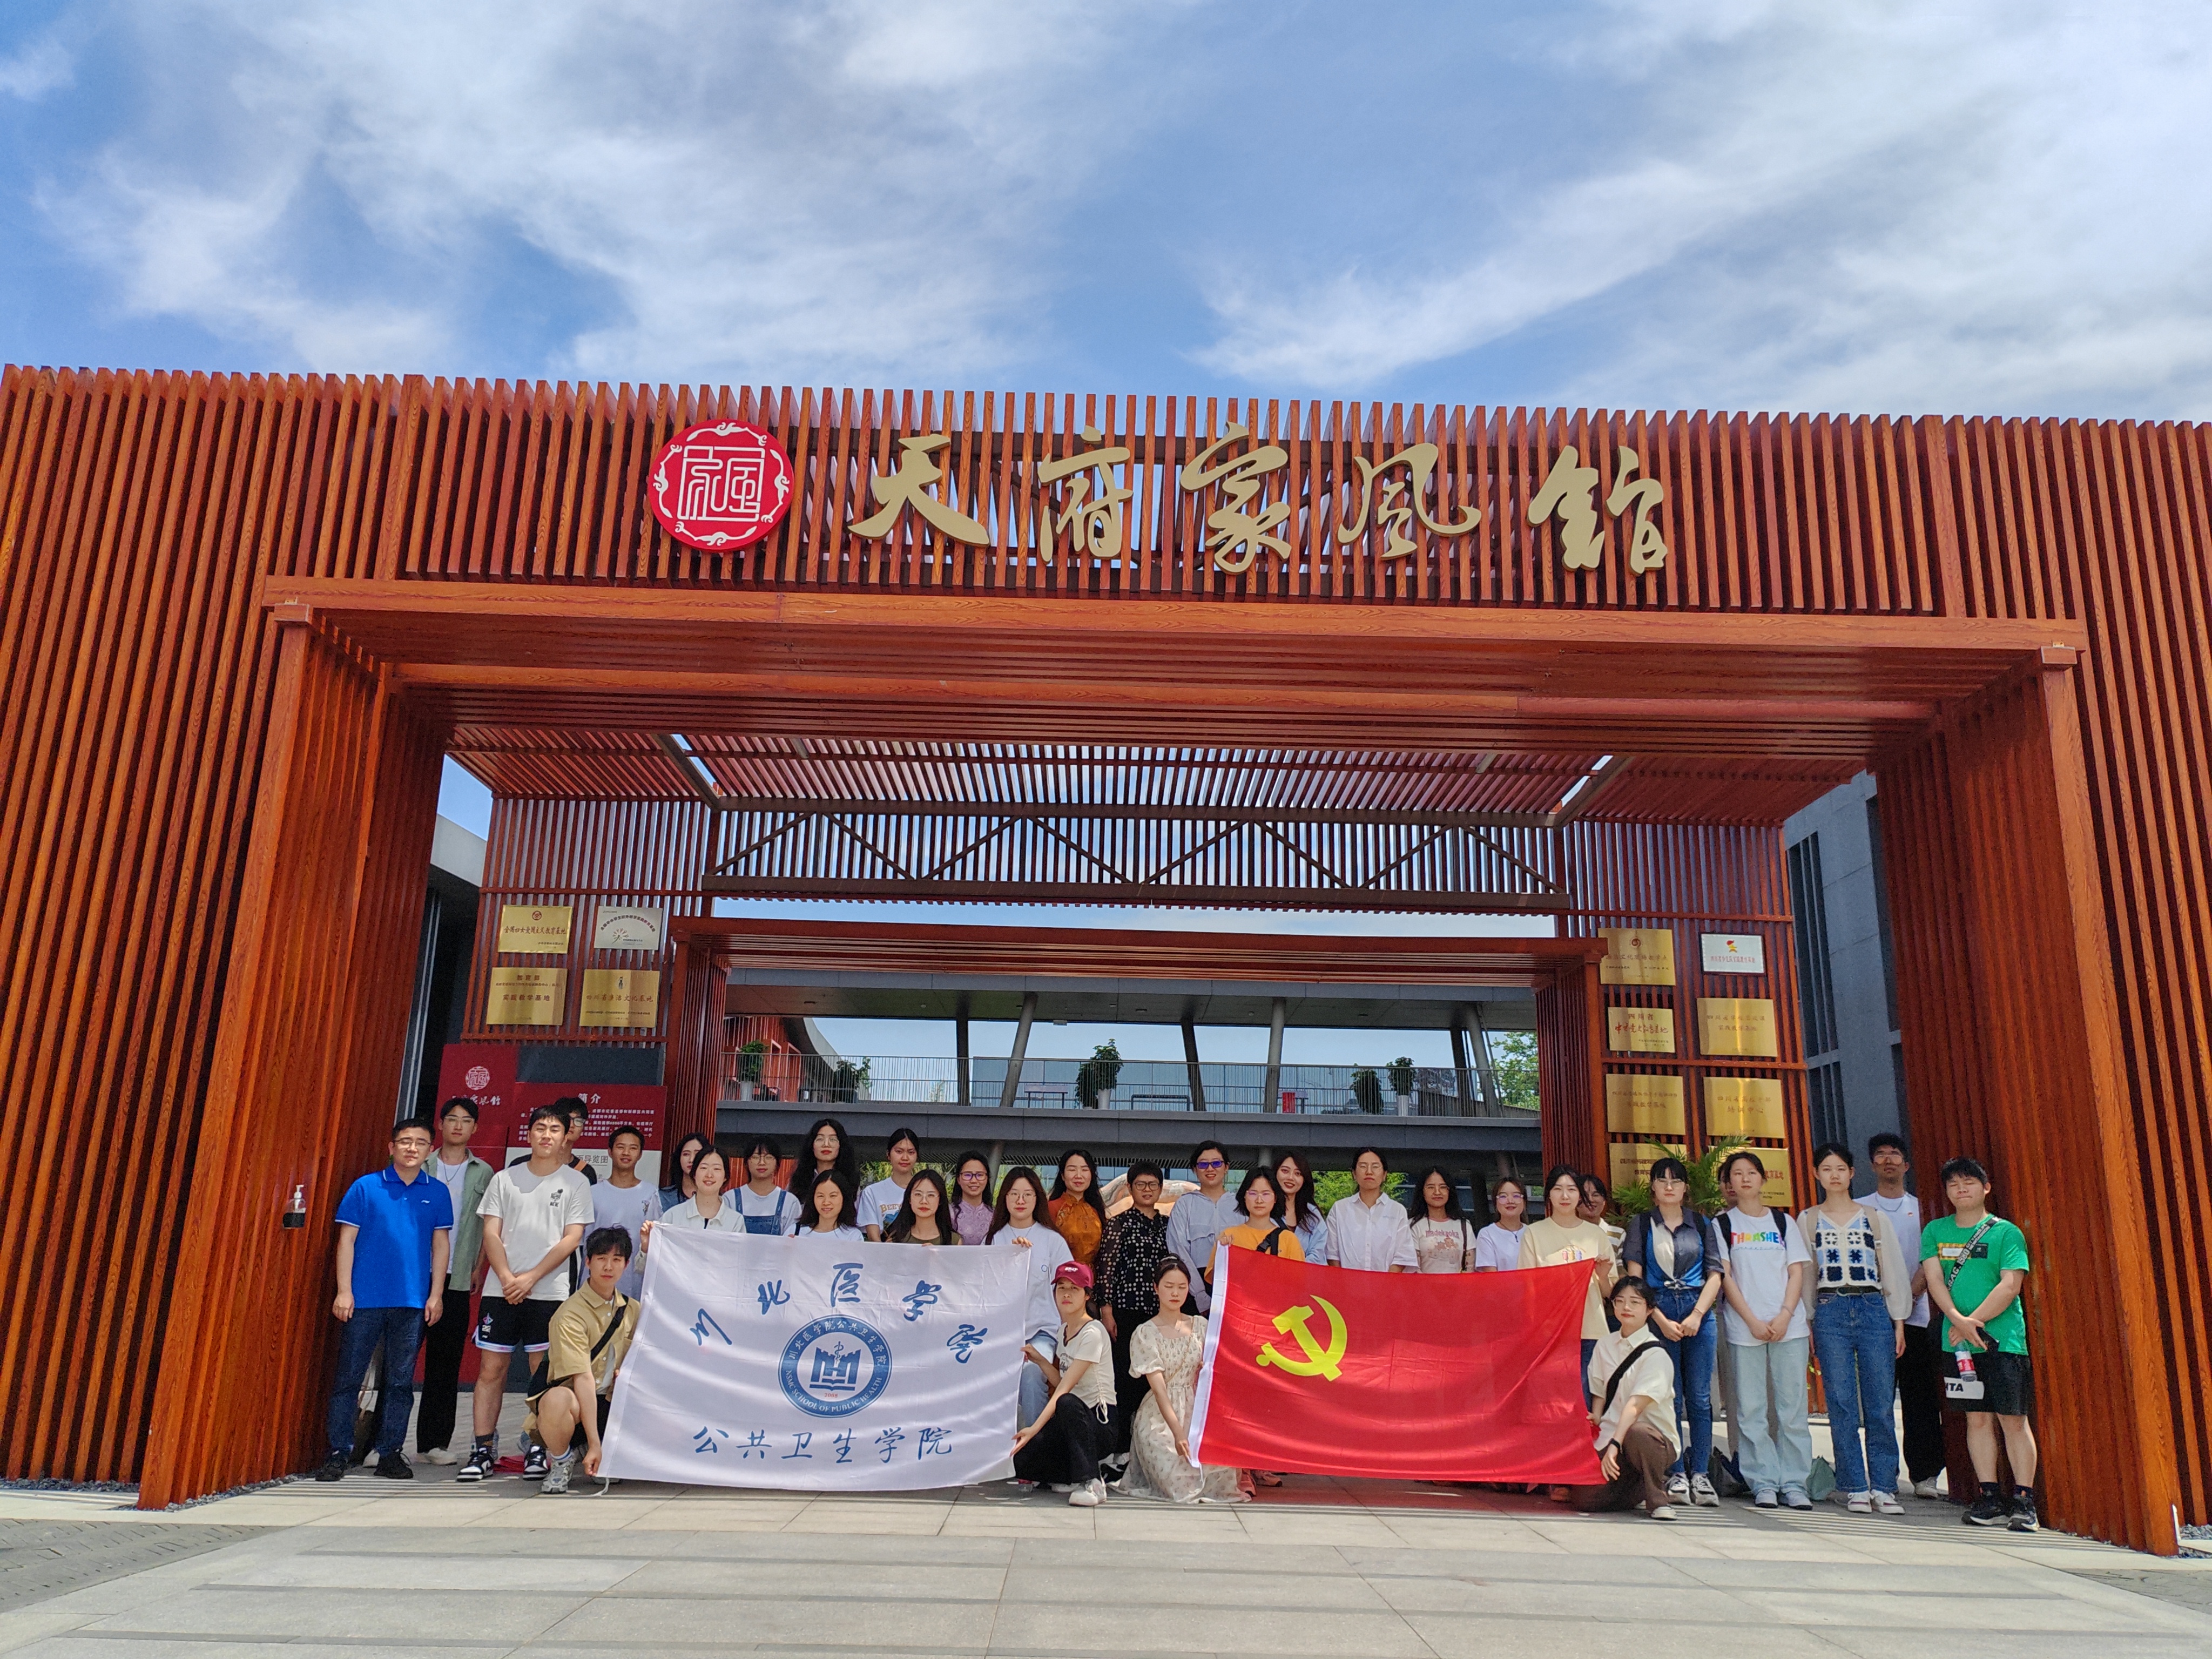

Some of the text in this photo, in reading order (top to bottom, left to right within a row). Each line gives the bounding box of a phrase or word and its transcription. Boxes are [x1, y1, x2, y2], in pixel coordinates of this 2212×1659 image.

[690, 1263, 988, 1364] 川北医学院
[792, 1388, 818, 1410] SCHOOL
[831, 1399, 860, 1412] PUBLIC
[860, 1377, 882, 1402] HEALTH
[693, 1426, 953, 1465] 公共卫生学院
